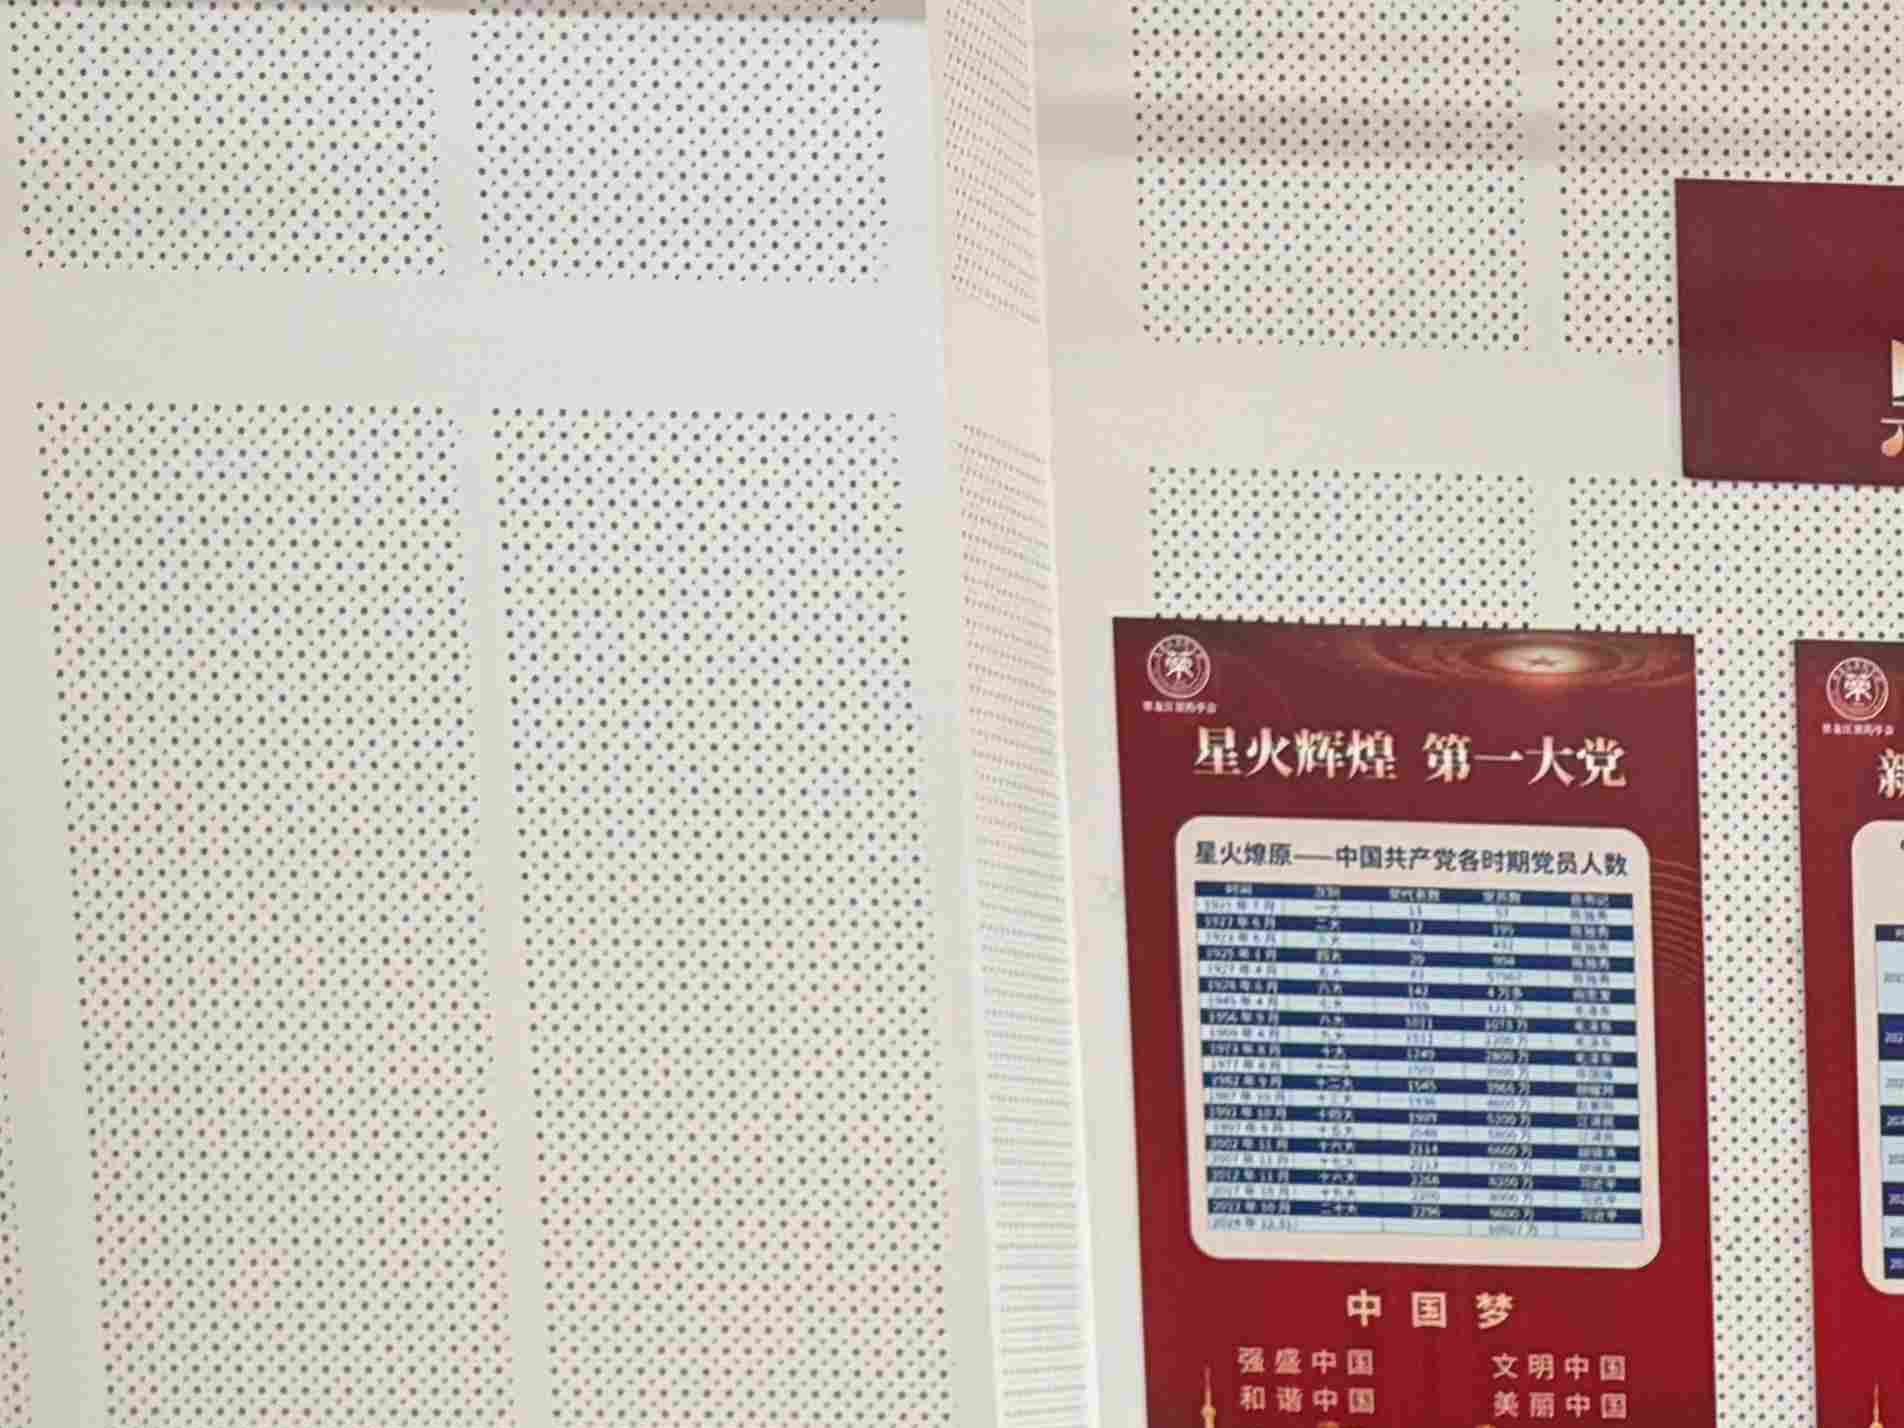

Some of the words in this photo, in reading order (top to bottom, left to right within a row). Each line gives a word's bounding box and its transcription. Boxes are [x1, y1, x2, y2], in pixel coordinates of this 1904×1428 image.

[1193, 724, 1398, 782] 星火辉煌
[1421, 731, 1628, 788] 第一大党
[1194, 840, 1629, 878] 星火燎原——中国共产党各时期党员人数
[1346, 1289, 1514, 1330] 中国梦
[1237, 1347, 1375, 1377] 强盛中国
[1491, 1353, 1626, 1381] 文明中国
[1240, 1385, 1375, 1414] 和谐中国
[1493, 1392, 1627, 1420] 美丽中国
